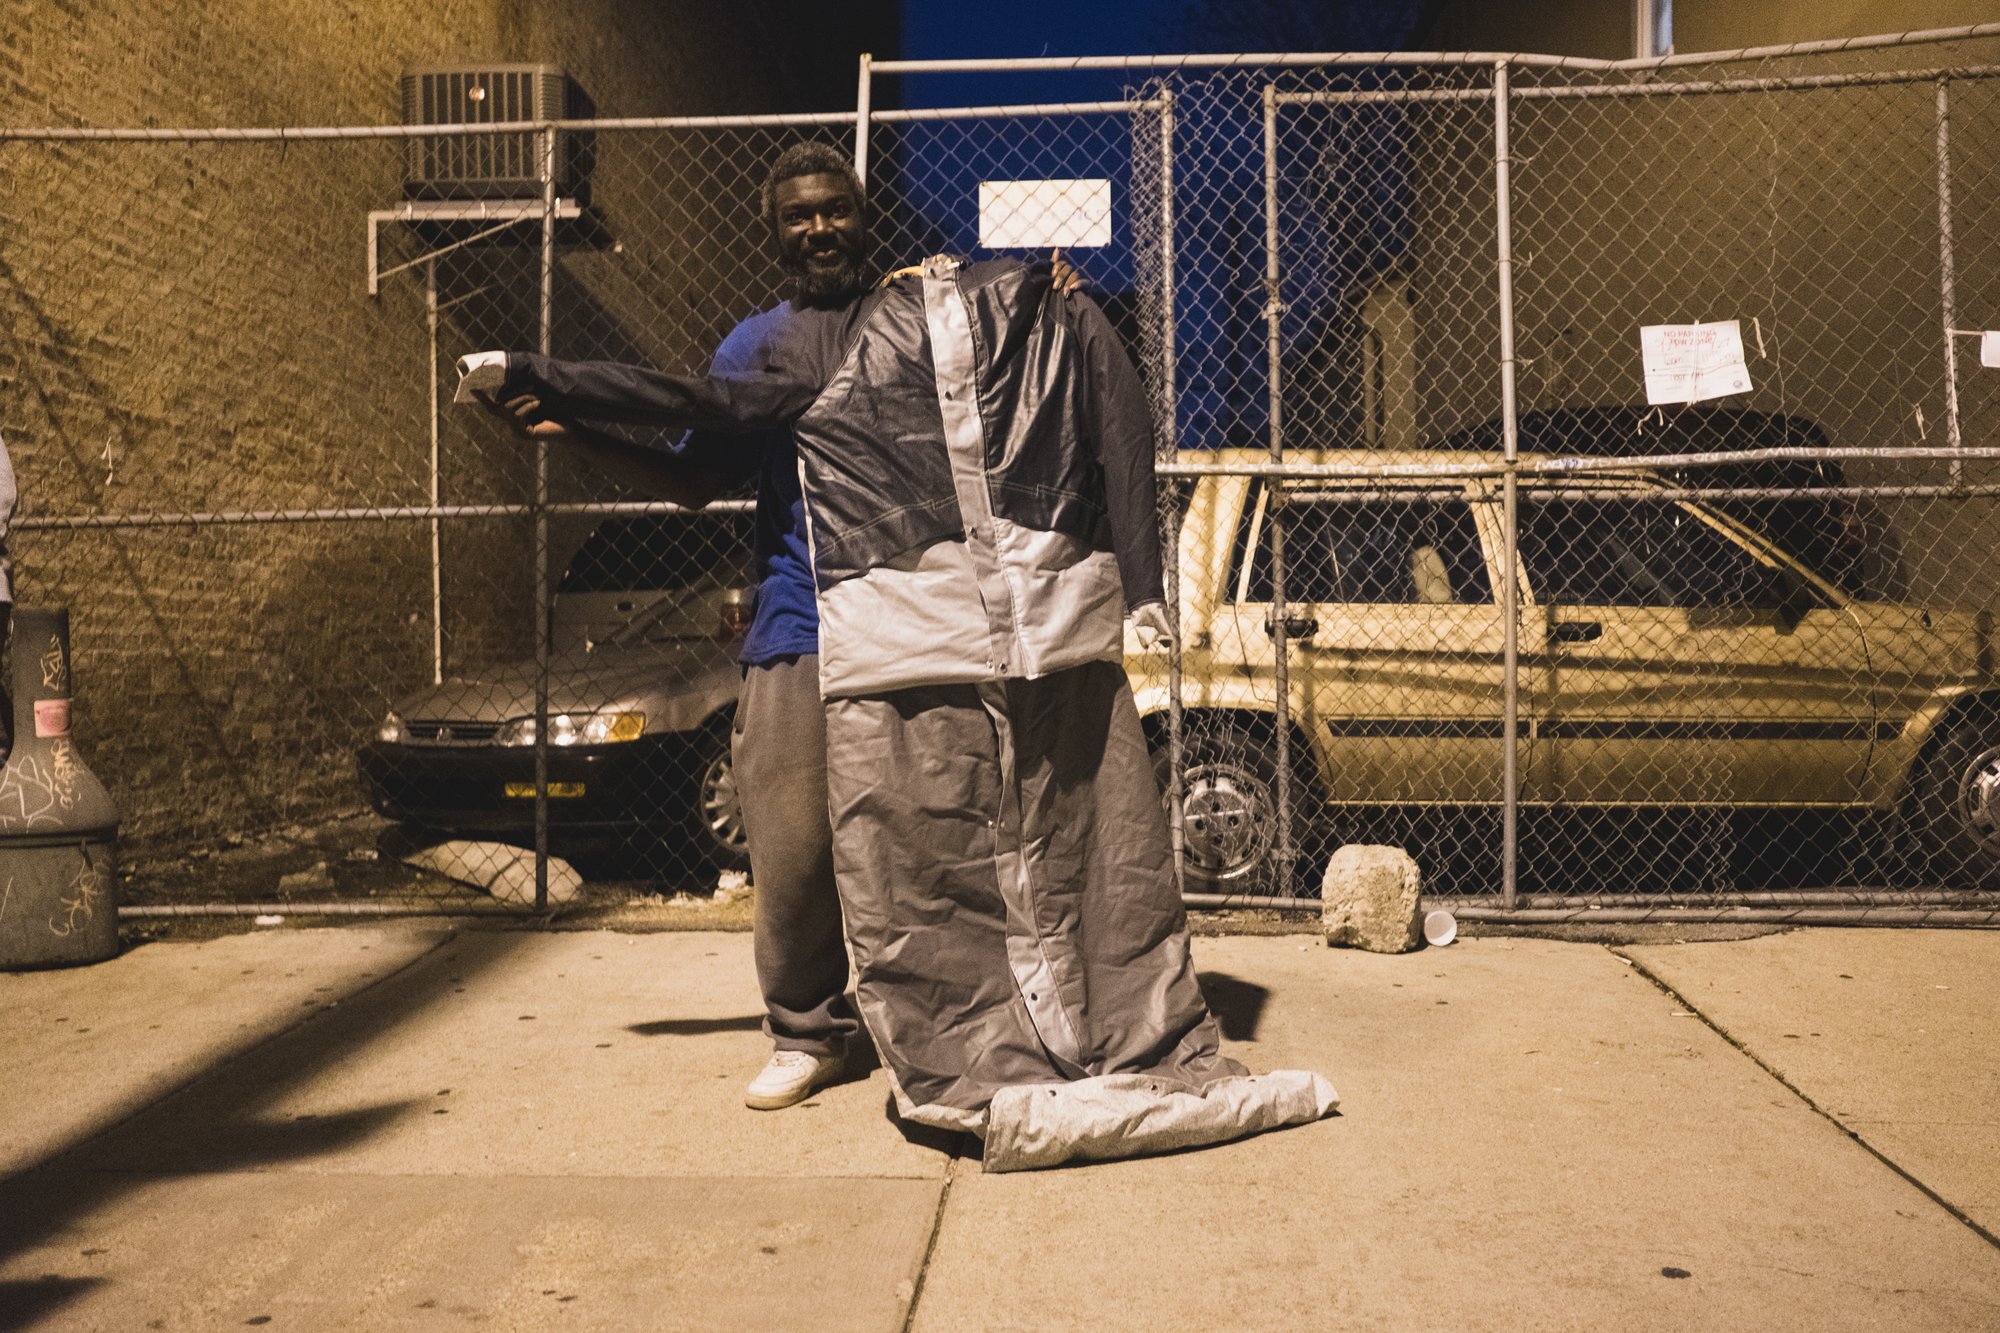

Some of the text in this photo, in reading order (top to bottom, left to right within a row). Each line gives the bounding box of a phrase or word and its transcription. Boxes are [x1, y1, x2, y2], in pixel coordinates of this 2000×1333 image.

[1678, 328, 1716, 337] PARING
[1693, 453, 1718, 462] ON
[1726, 450, 1757, 460] MY
[1764, 447, 1819, 457] MIND
